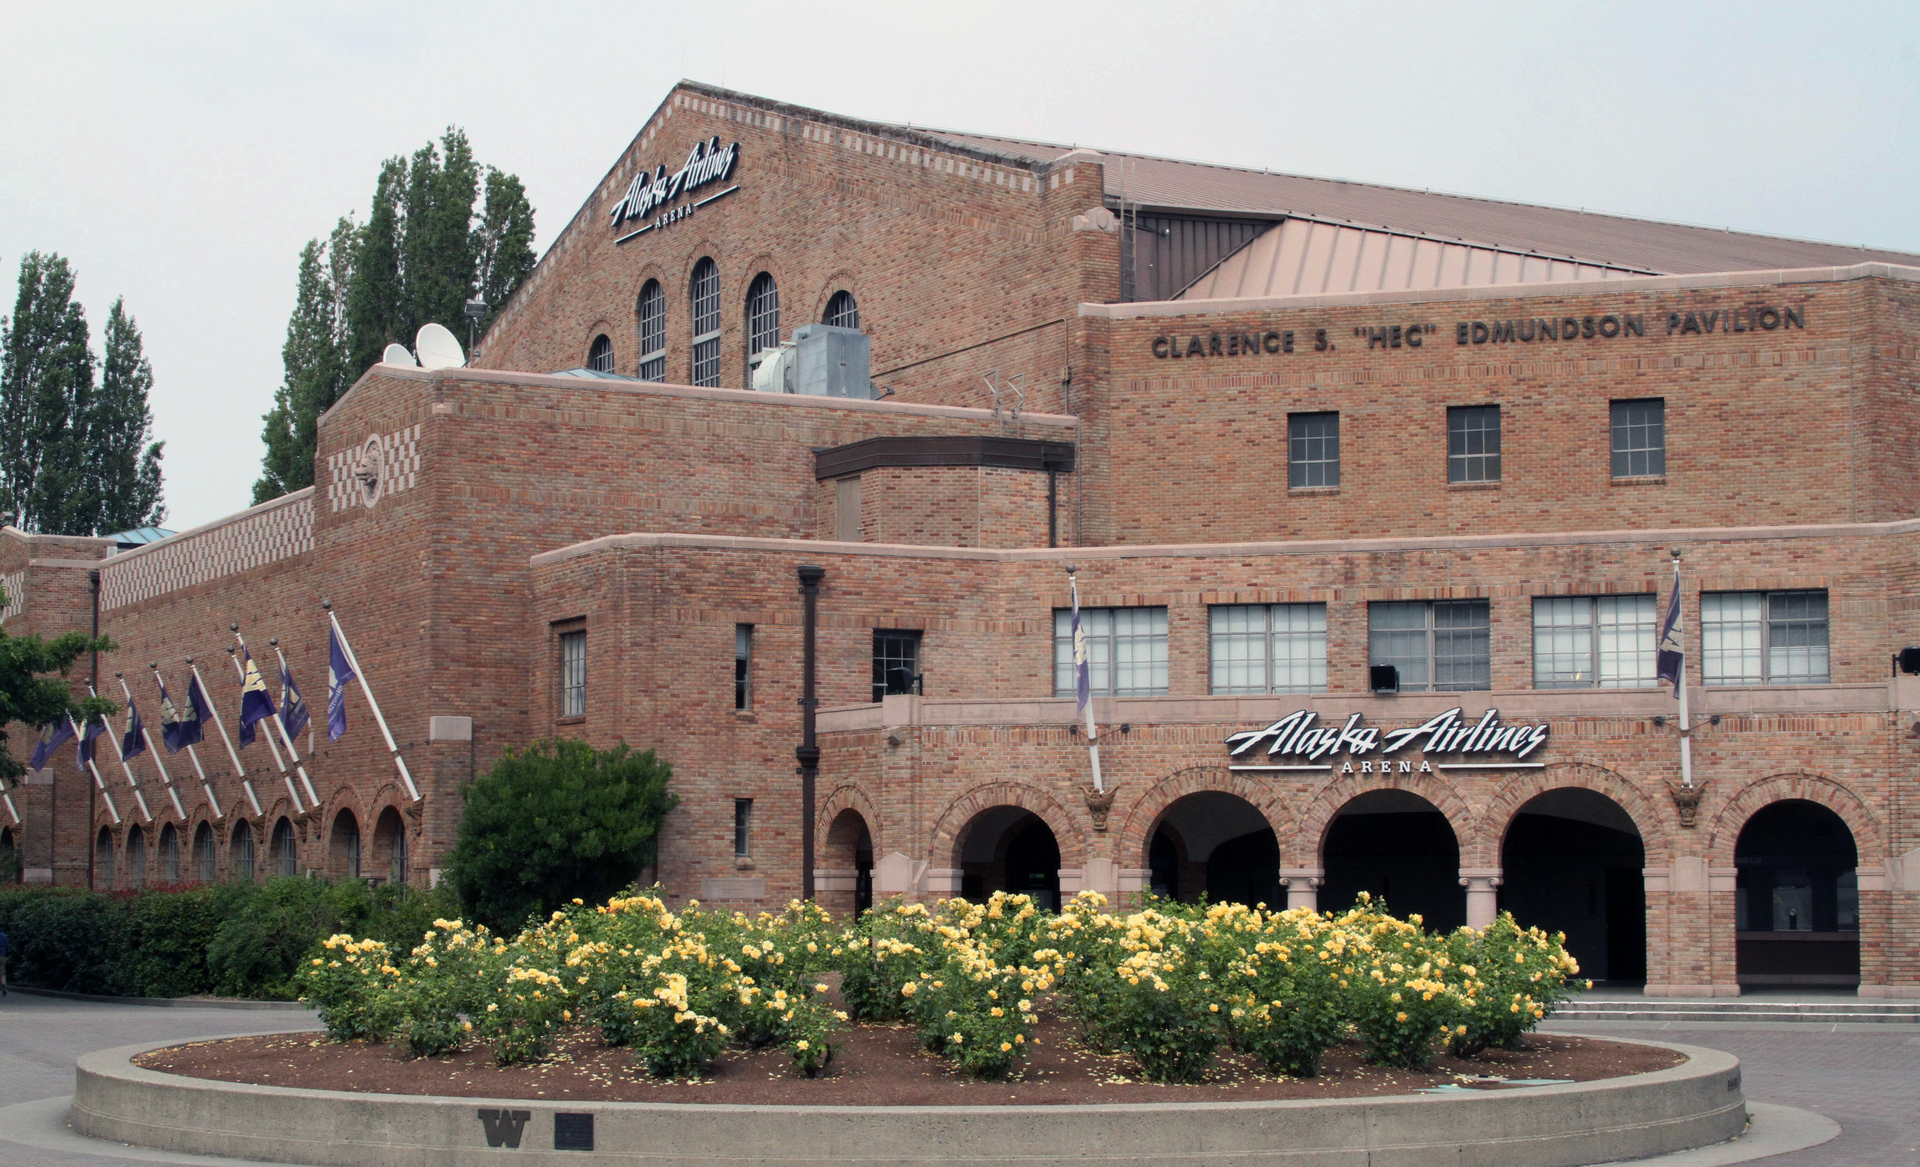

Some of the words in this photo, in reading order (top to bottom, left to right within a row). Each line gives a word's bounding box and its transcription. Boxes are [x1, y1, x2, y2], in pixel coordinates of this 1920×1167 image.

[610, 165, 671, 227] Alaska
[667, 135, 741, 200] Airlines
[655, 203, 693, 229] ARENA
[1151, 330, 1295, 358] CLARENCE
[1314, 328, 1336, 351] S.
[1456, 313, 1645, 345] EDMUNDSON
[1666, 305, 1805, 335] PAVILION
[1224, 708, 1382, 761] Alaska
[1381, 706, 1549, 759] Airlines
[1341, 760, 1433, 774] ARENA
[477, 1108, 531, 1149] W
